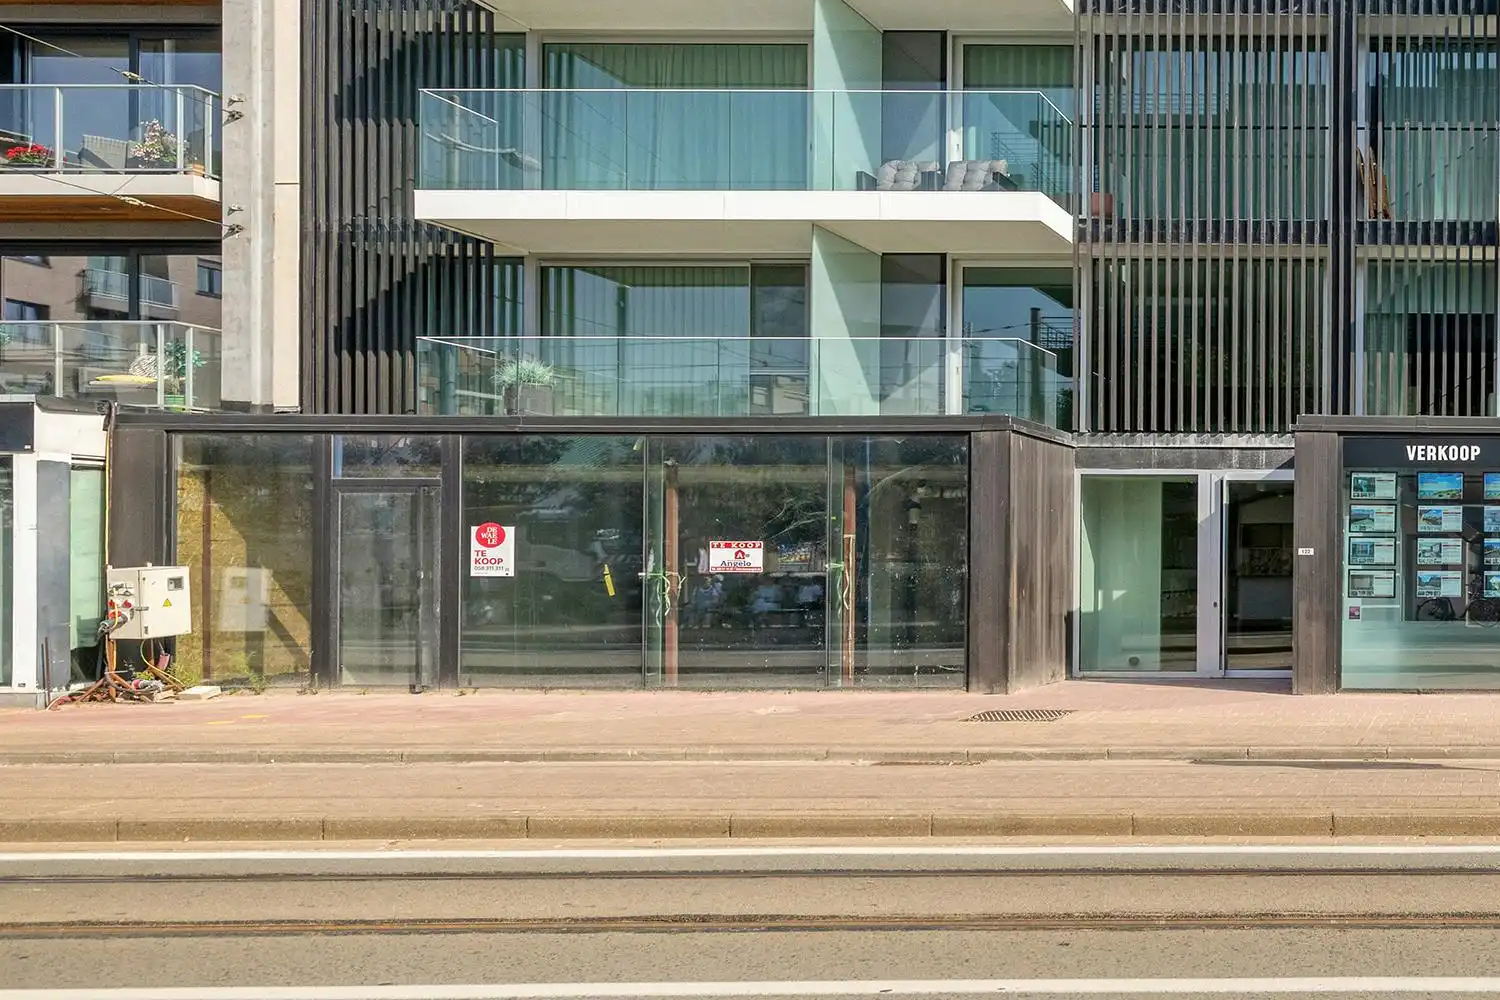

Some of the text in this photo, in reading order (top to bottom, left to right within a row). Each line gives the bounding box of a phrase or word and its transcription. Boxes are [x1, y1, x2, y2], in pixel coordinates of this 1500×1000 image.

[1406, 445, 1481, 461] VERKOOP
[474, 549, 487, 557] TE
[474, 557, 504, 565] KOOP
[720, 560, 752, 568] Angelo
